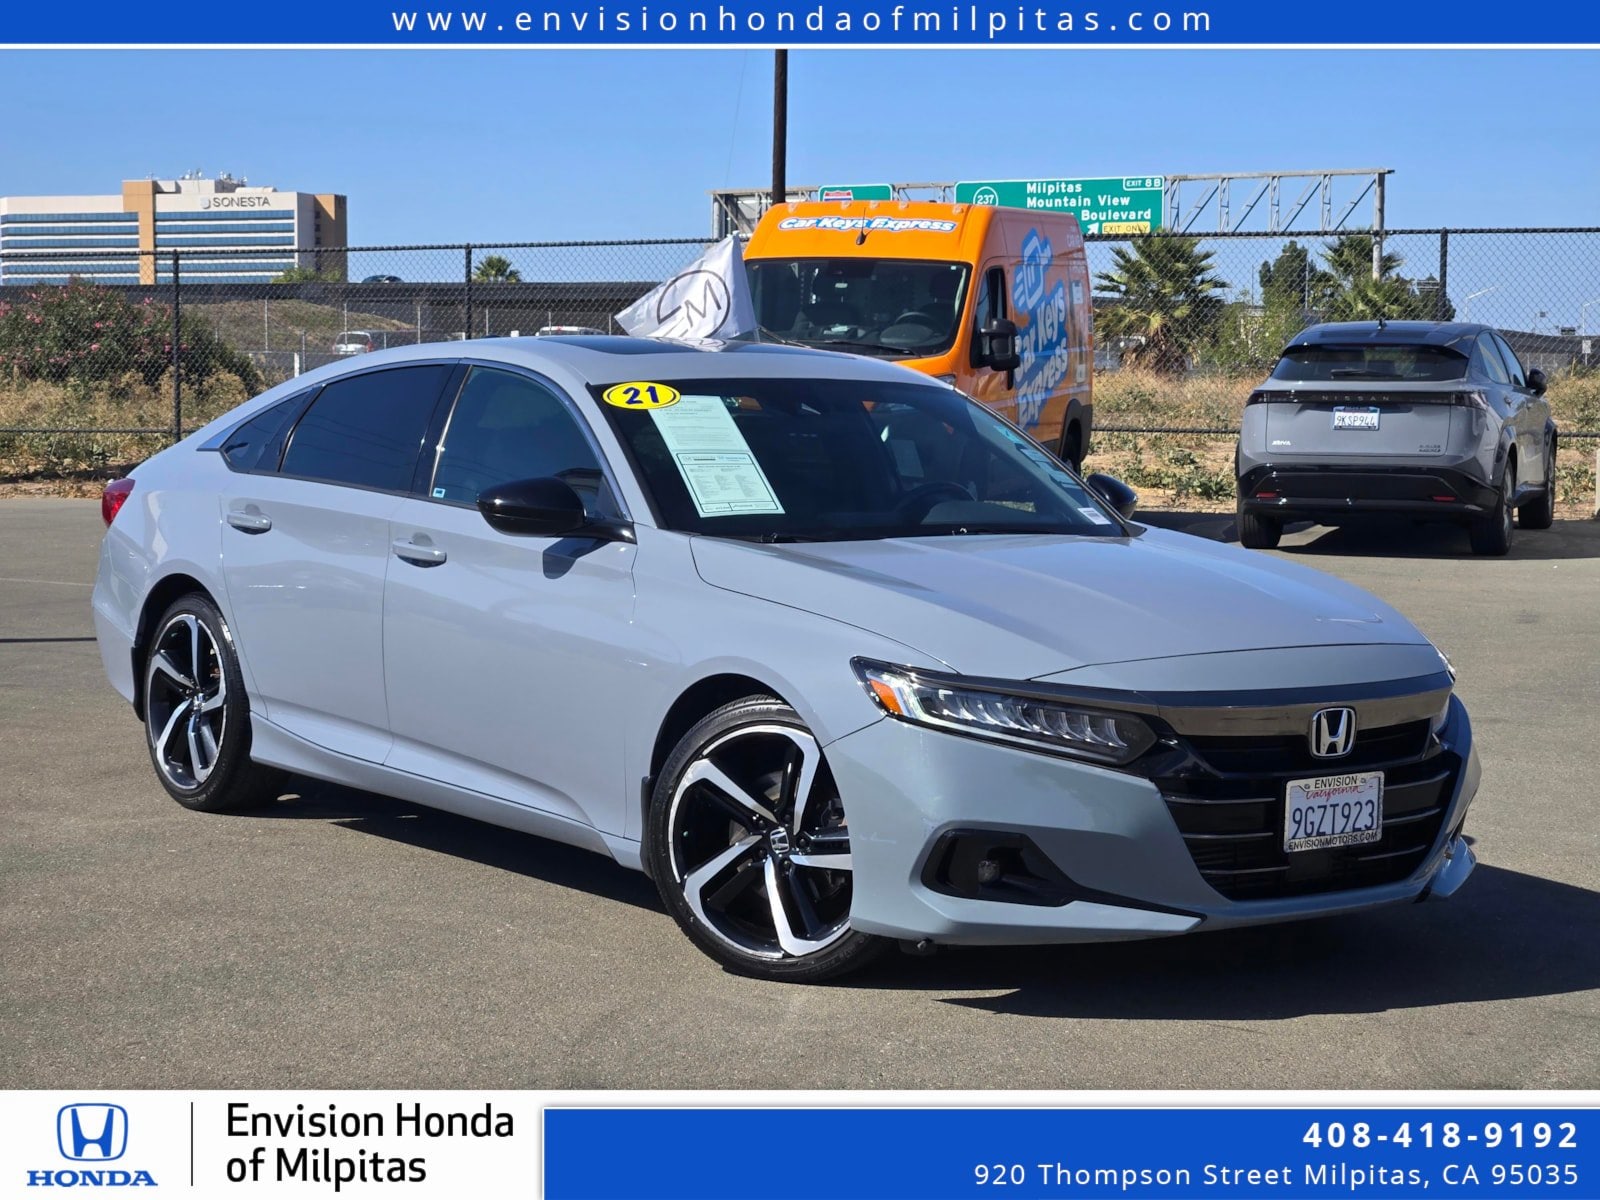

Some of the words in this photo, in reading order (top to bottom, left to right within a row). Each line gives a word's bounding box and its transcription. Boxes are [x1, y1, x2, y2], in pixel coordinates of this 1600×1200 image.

[1026, 182, 1082, 196] Milpitas
[212, 196, 271, 208] SONESTA
[977, 194, 995, 205] 237
[1026, 195, 1091, 208] Mountain
[1097, 194, 1130, 206] View
[1081, 208, 1151, 221] Boulevard
[780, 217, 818, 230] Car
[817, 216, 868, 231] Keys
[868, 216, 957, 232] Express
[1103, 225, 1121, 233] EXIT
[1125, 224, 1149, 233] ONLY
[1036, 286, 1066, 353] Keys
[1018, 337, 1068, 430] Express
[622, 385, 661, 406] 21
[1336, 415, 1376, 426] 9KSP944
[1314, 775, 1358, 789] ENVISION
[1291, 799, 1376, 840] 9GZT923
[1288, 831, 1378, 850] ENVISIONMOTORS.COM
